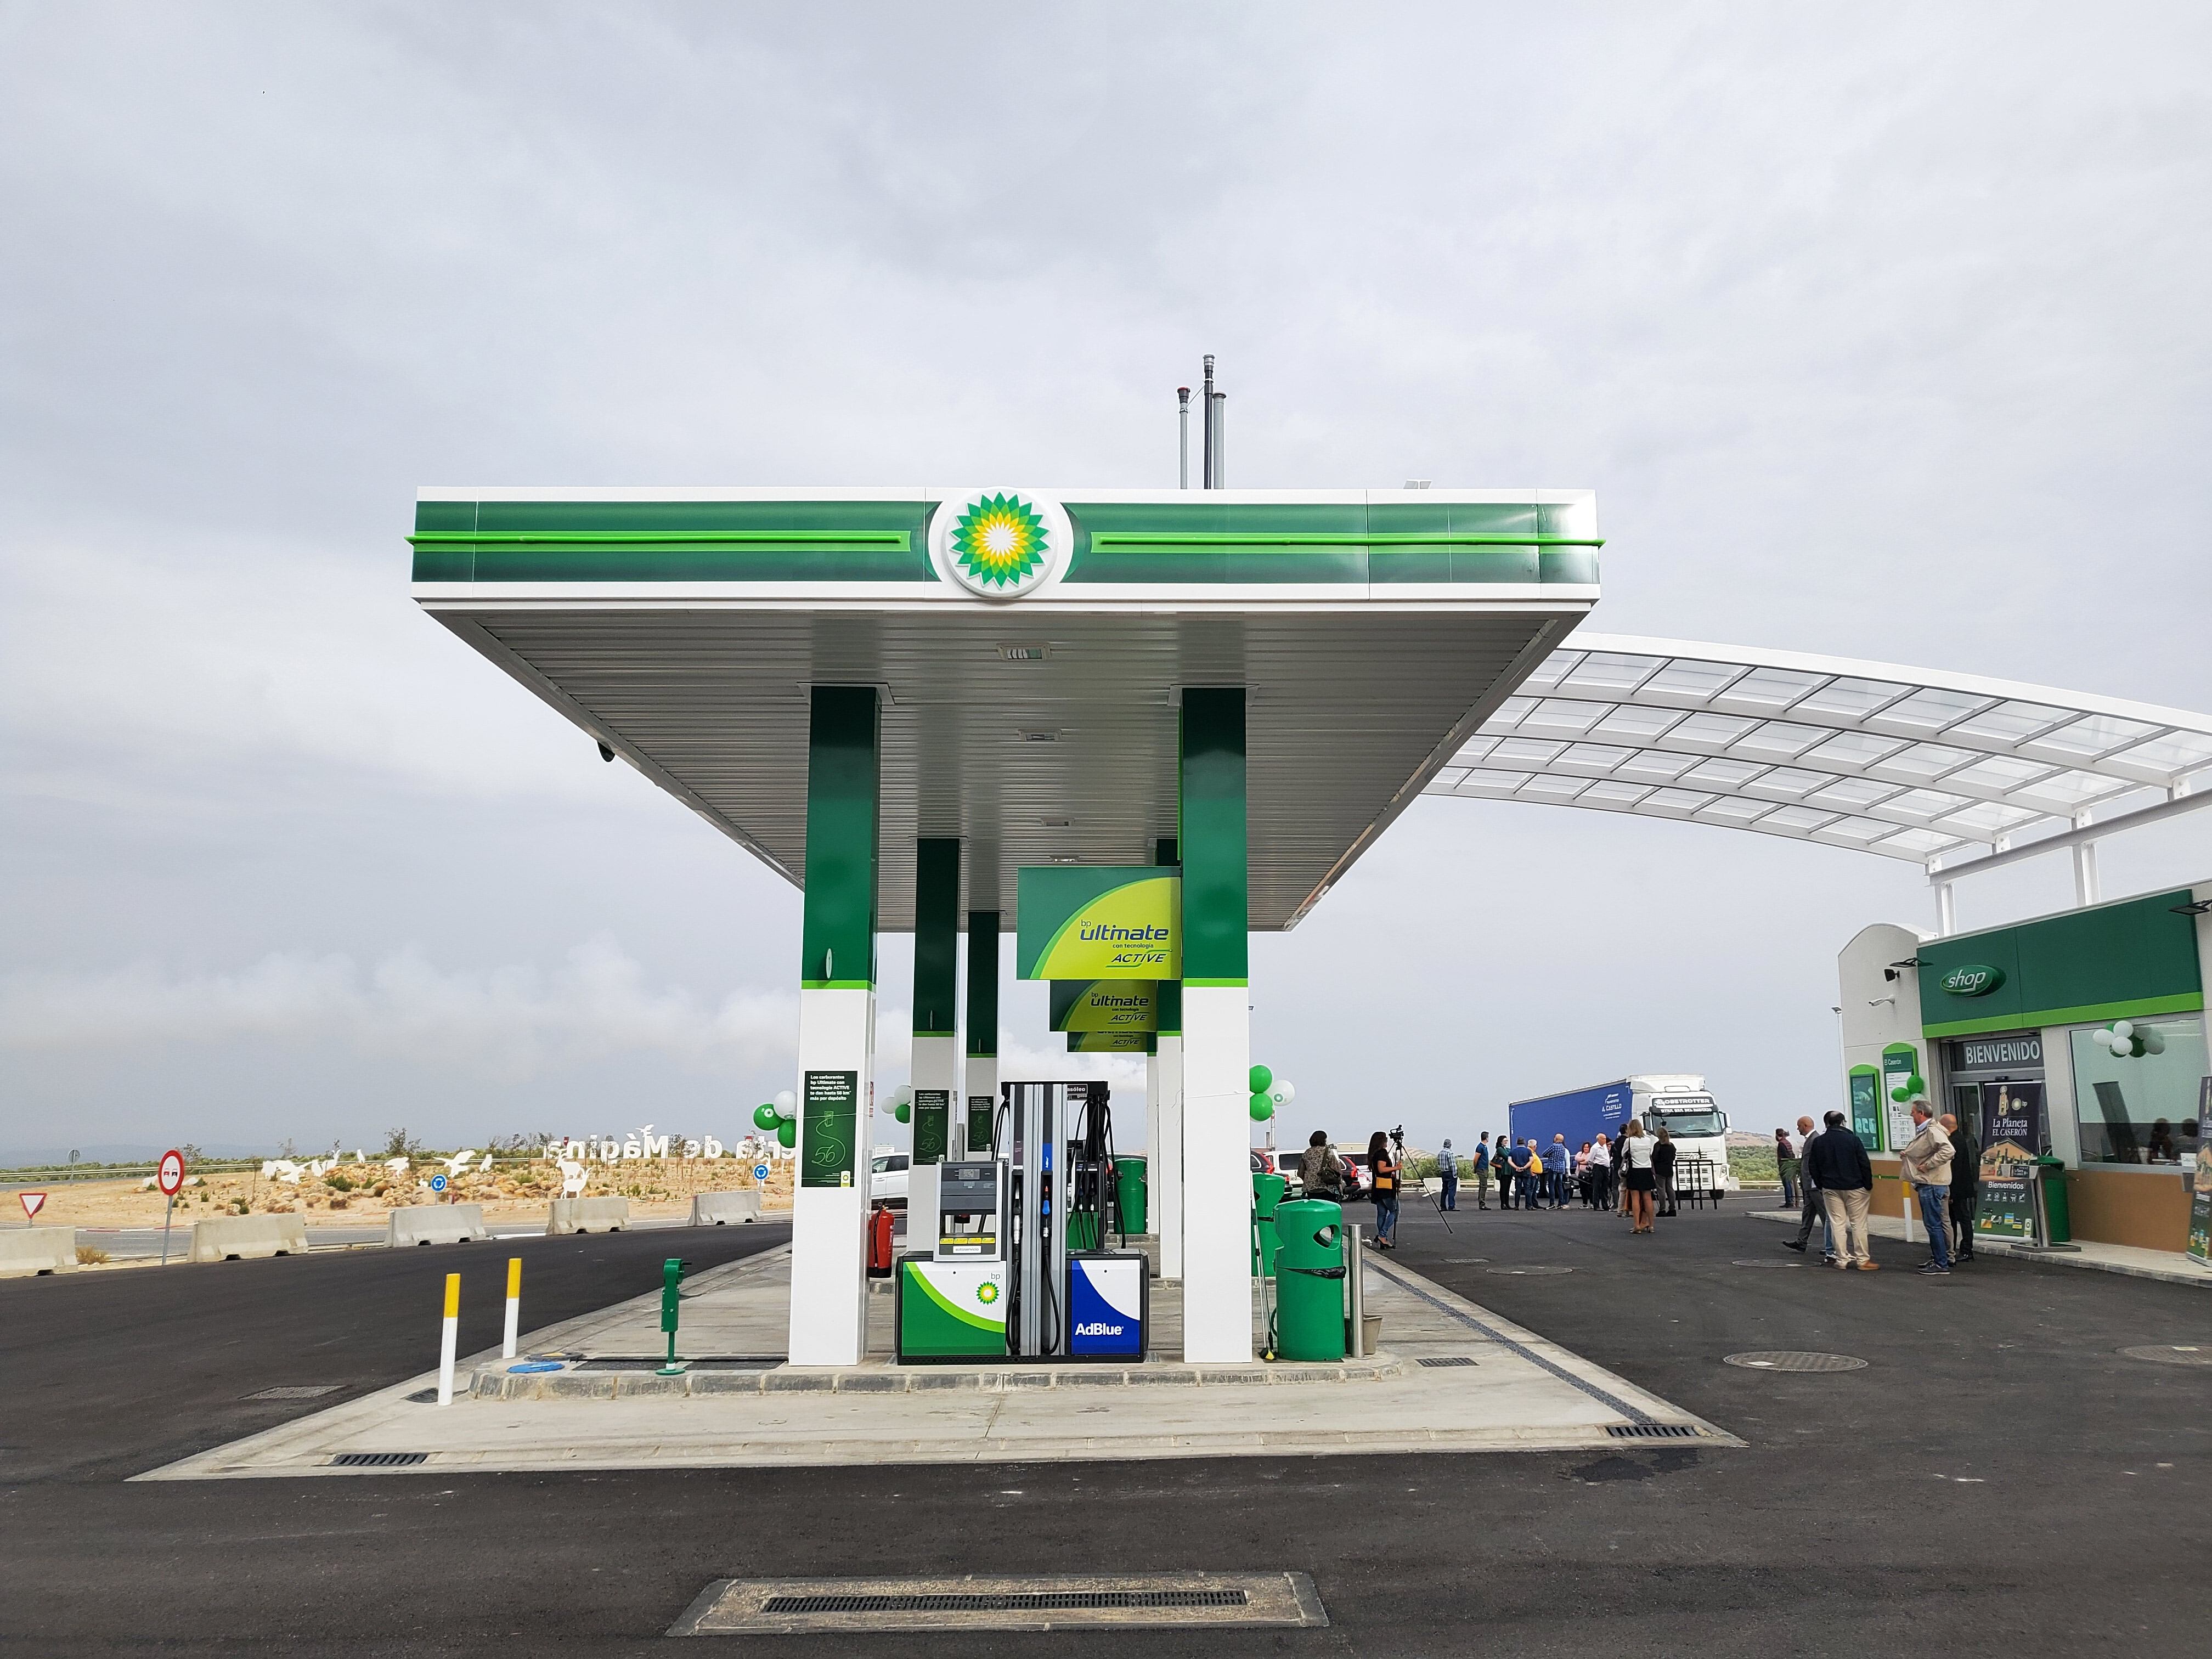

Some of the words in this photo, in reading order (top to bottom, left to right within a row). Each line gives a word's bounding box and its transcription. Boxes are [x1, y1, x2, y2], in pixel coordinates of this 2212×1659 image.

[1081, 919, 1091, 928] bp
[1080, 924, 1169, 940] ultimate
[1111, 953, 1167, 963] ACTIVE
[1948, 969, 1986, 991] shop
[1091, 995, 1149, 1006] ultimate
[1965, 1041, 2040, 1064] BIENVENIDO
[1993, 1119, 2000, 1127] La
[2002, 1118, 2028, 1127] Planeta
[2000, 1126, 2028, 1136] CASERÓN
[812, 1145, 835, 1163] 56
[1988, 1181, 2024, 1189] Bienvenidos
[991, 1272, 1001, 1281] bp
[1075, 1323, 1122, 1335] AdBlue
